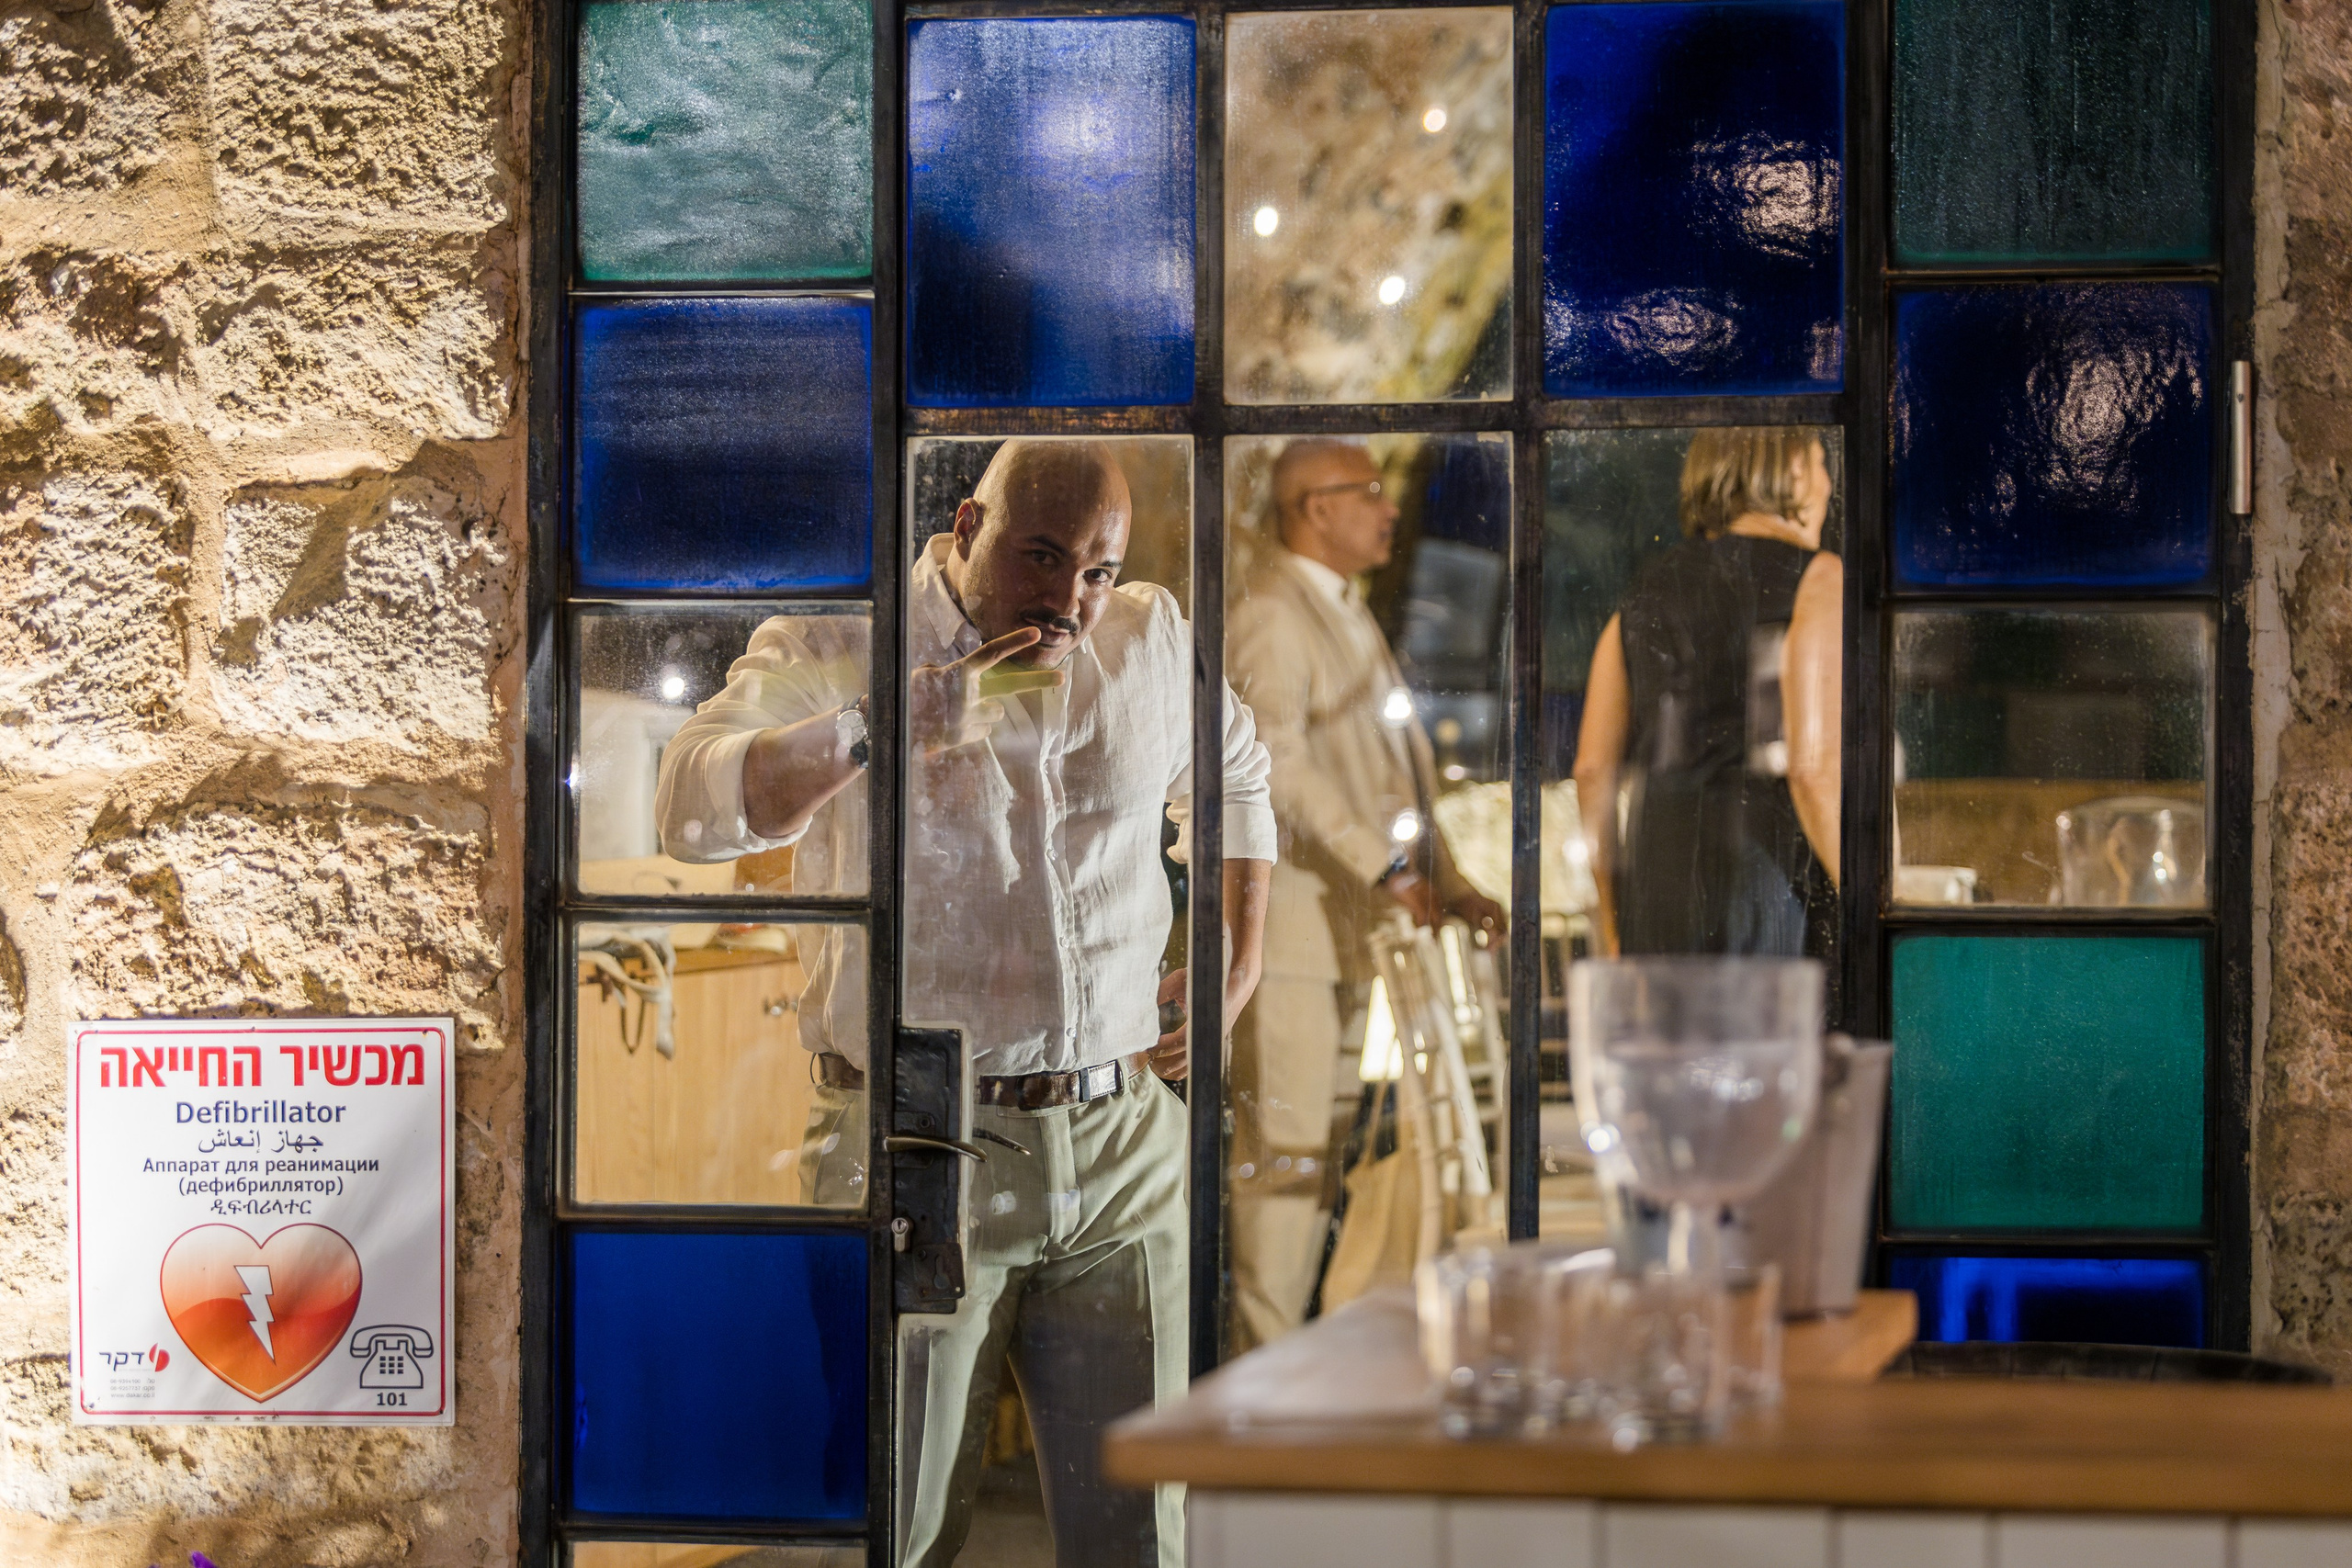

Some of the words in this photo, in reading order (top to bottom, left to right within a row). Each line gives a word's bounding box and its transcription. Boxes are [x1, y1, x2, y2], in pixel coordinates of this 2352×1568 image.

[100, 1045, 262, 1089] החייאה
[279, 1043, 425, 1087] מכשיר
[175, 1100, 347, 1124] Defibrillator
[198, 1128, 261, 1155] إنعاش
[271, 1129, 324, 1155] جهاز
[142, 1157, 219, 1175] Аппарат
[224, 1160, 259, 1175] для
[265, 1159, 379, 1175] реанимации
[178, 1176, 345, 1196] (дефибриллятор)
[98, 1351, 145, 1371] דקר
[377, 1392, 408, 1406] 101
